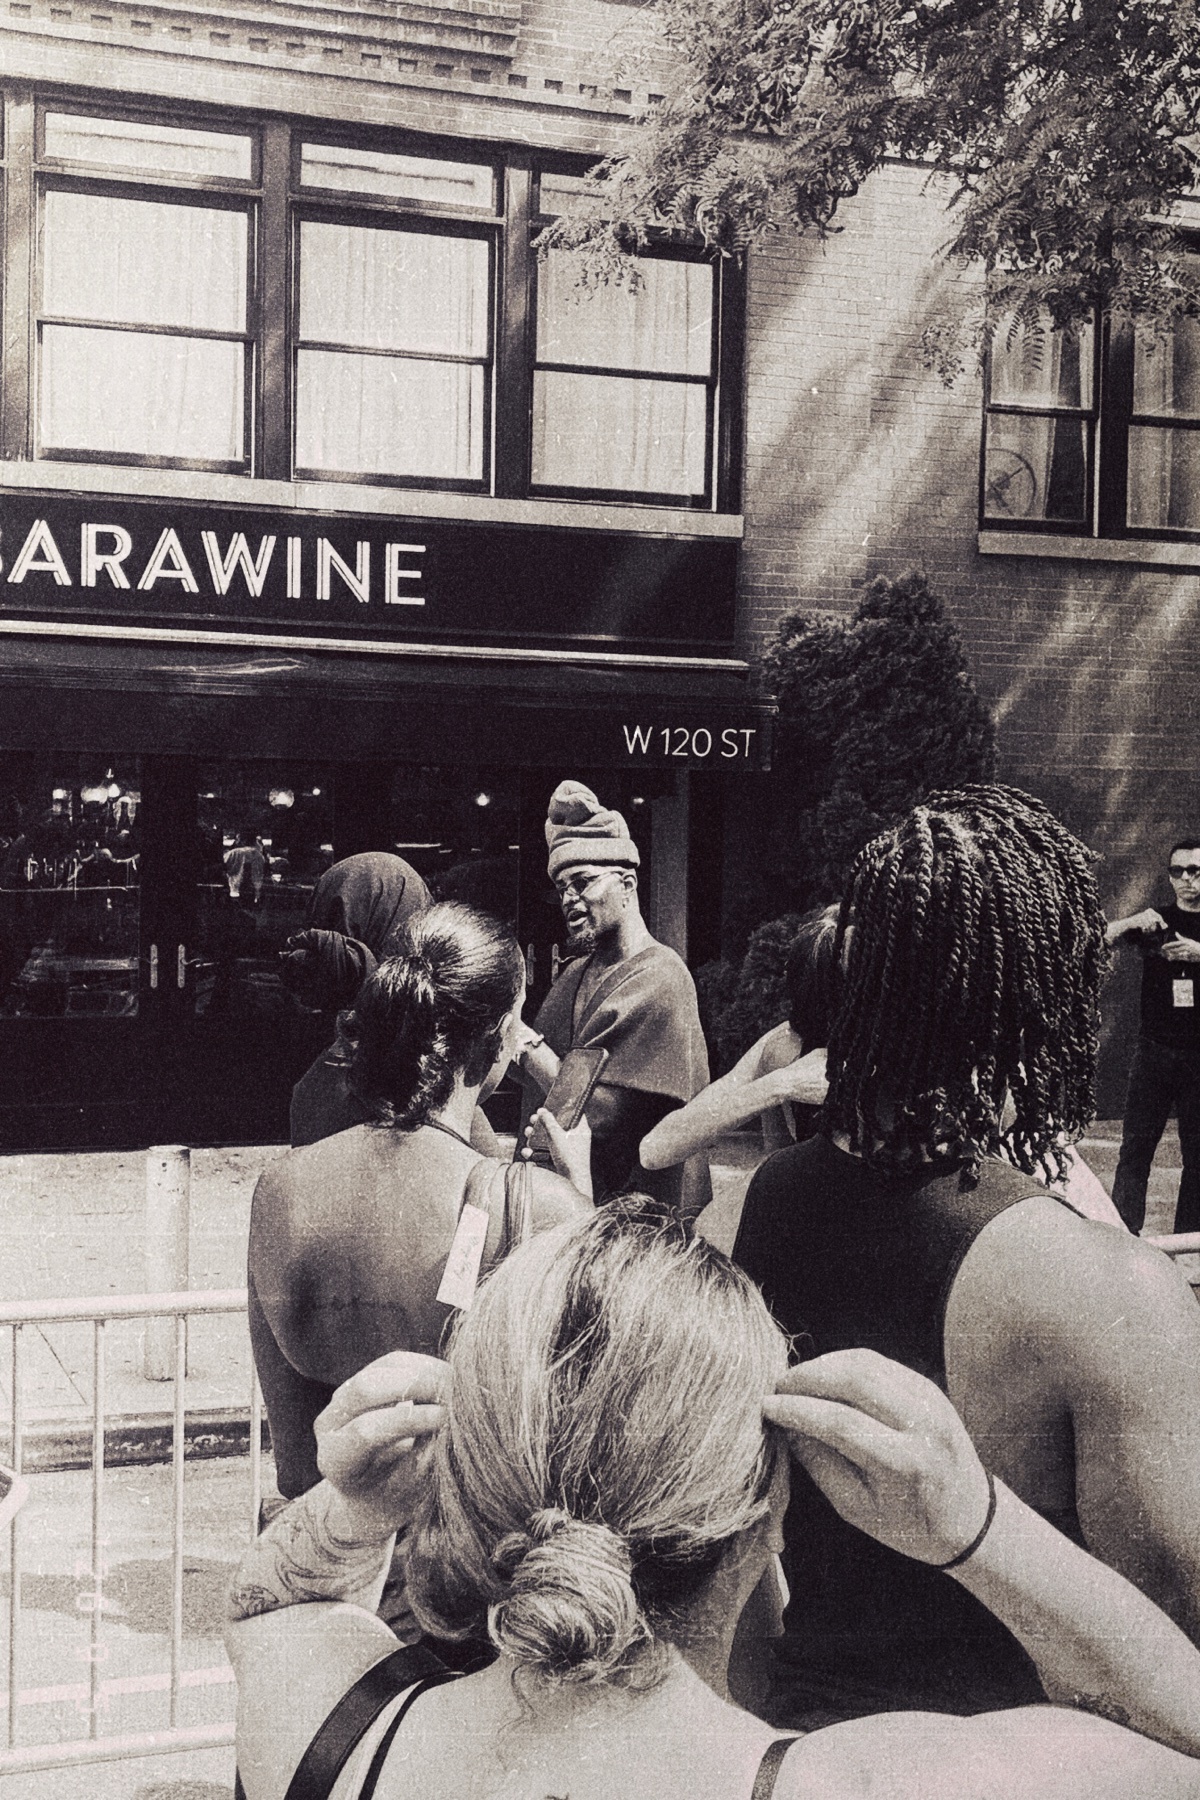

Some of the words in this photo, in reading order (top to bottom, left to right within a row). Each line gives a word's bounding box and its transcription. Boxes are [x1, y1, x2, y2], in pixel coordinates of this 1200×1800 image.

[0, 519, 426, 606] ARAWINE
[622, 724, 653, 755] W
[660, 727, 712, 757] 120
[720, 728, 757, 758] ST
